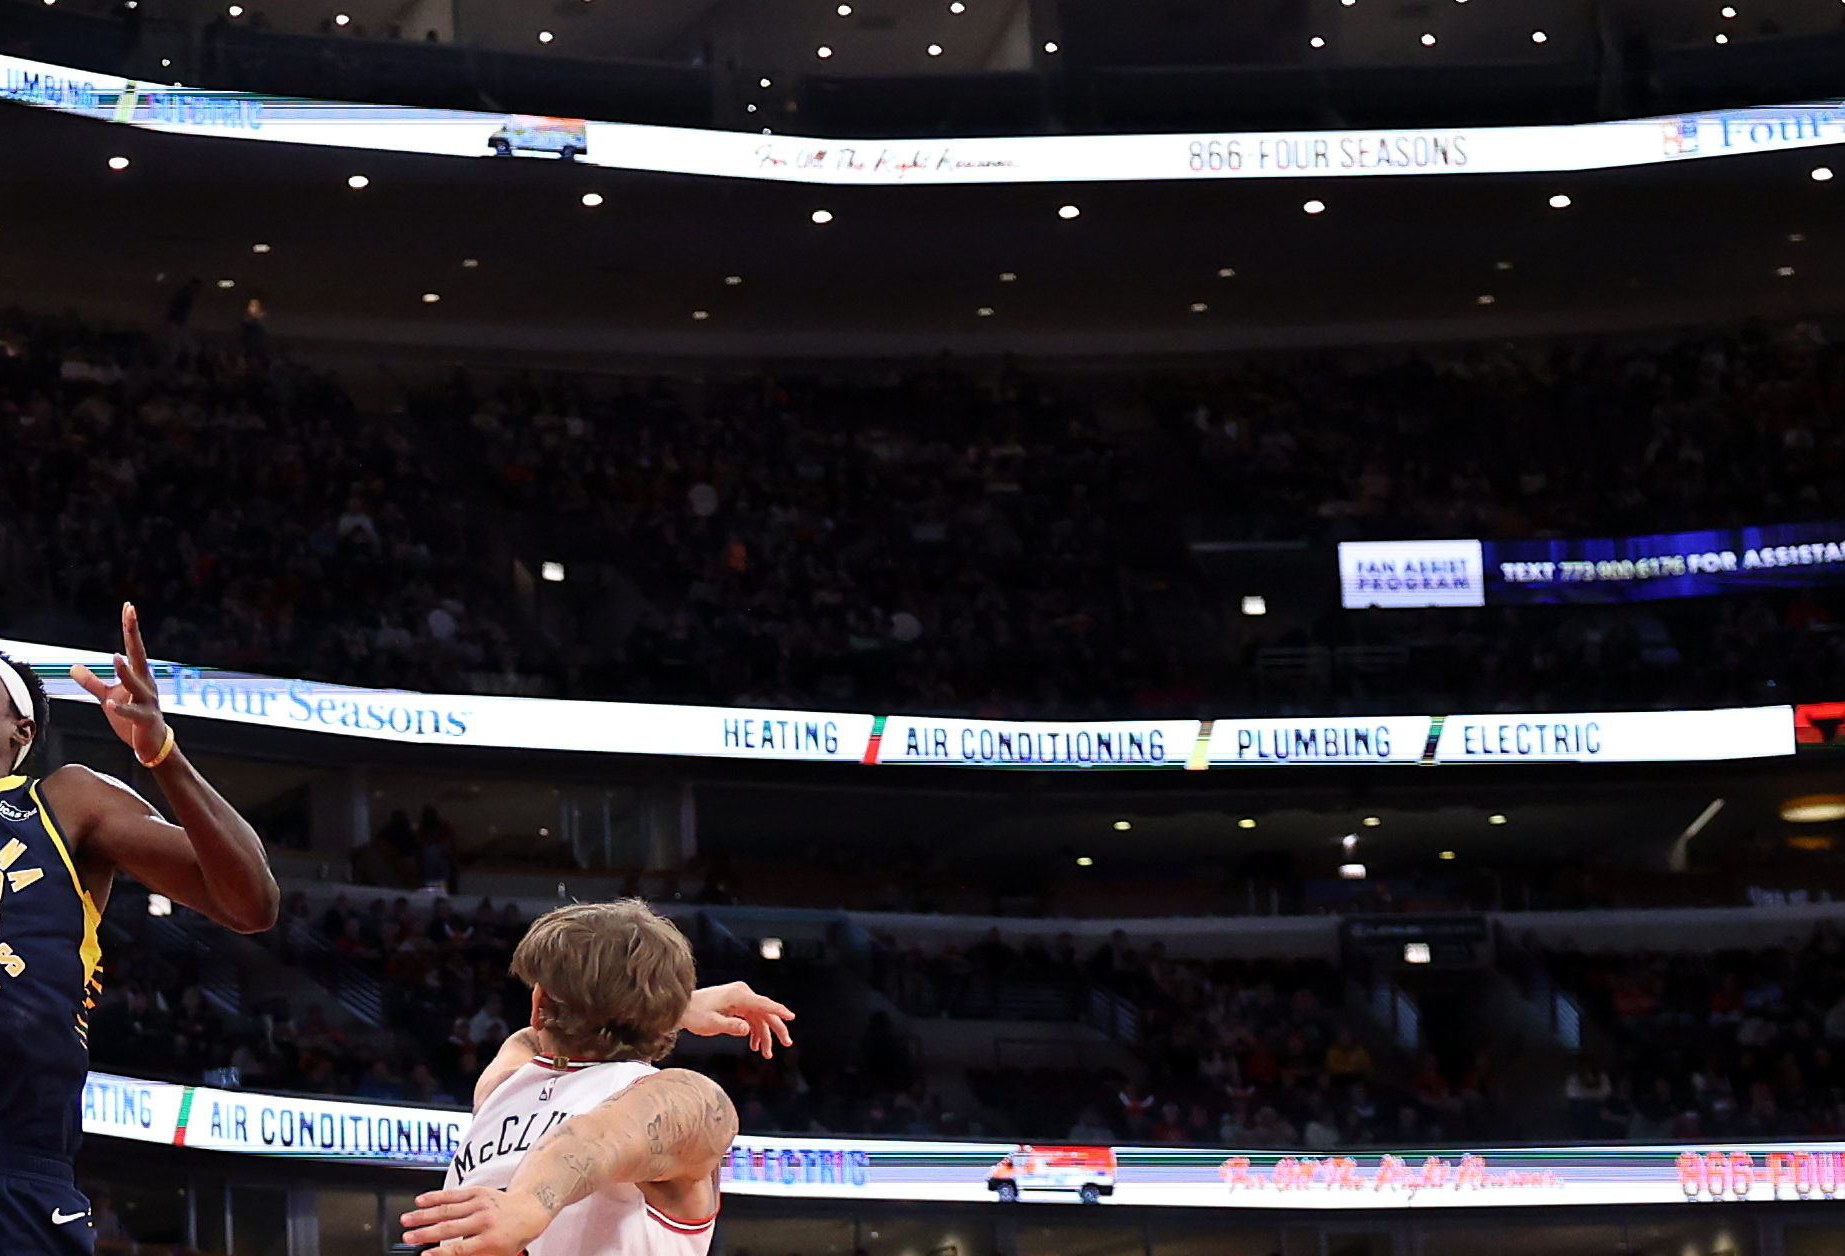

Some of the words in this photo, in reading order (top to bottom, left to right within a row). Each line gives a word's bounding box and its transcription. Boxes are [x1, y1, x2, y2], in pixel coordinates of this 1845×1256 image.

[1189, 138, 1330, 171] 866-FOUR
[1340, 135, 1468, 168] SEASONS
[1500, 561, 1555, 582] TEXT
[1687, 551, 1739, 574] FOR
[170, 665, 277, 717] Four
[287, 679, 468, 737] Seasons
[723, 718, 838, 754] HEATING
[905, 726, 949, 758] AIR
[961, 728, 1166, 765] CONDITIONING
[1238, 725, 1392, 758] PLUMBING
[1463, 722, 1602, 755] ELECTRIC
[83, 1082, 152, 1129] ATING
[211, 1101, 249, 1143] AIR
[260, 1108, 460, 1156] CONDITIONING
[730, 1145, 870, 1186] ELECTRIC
